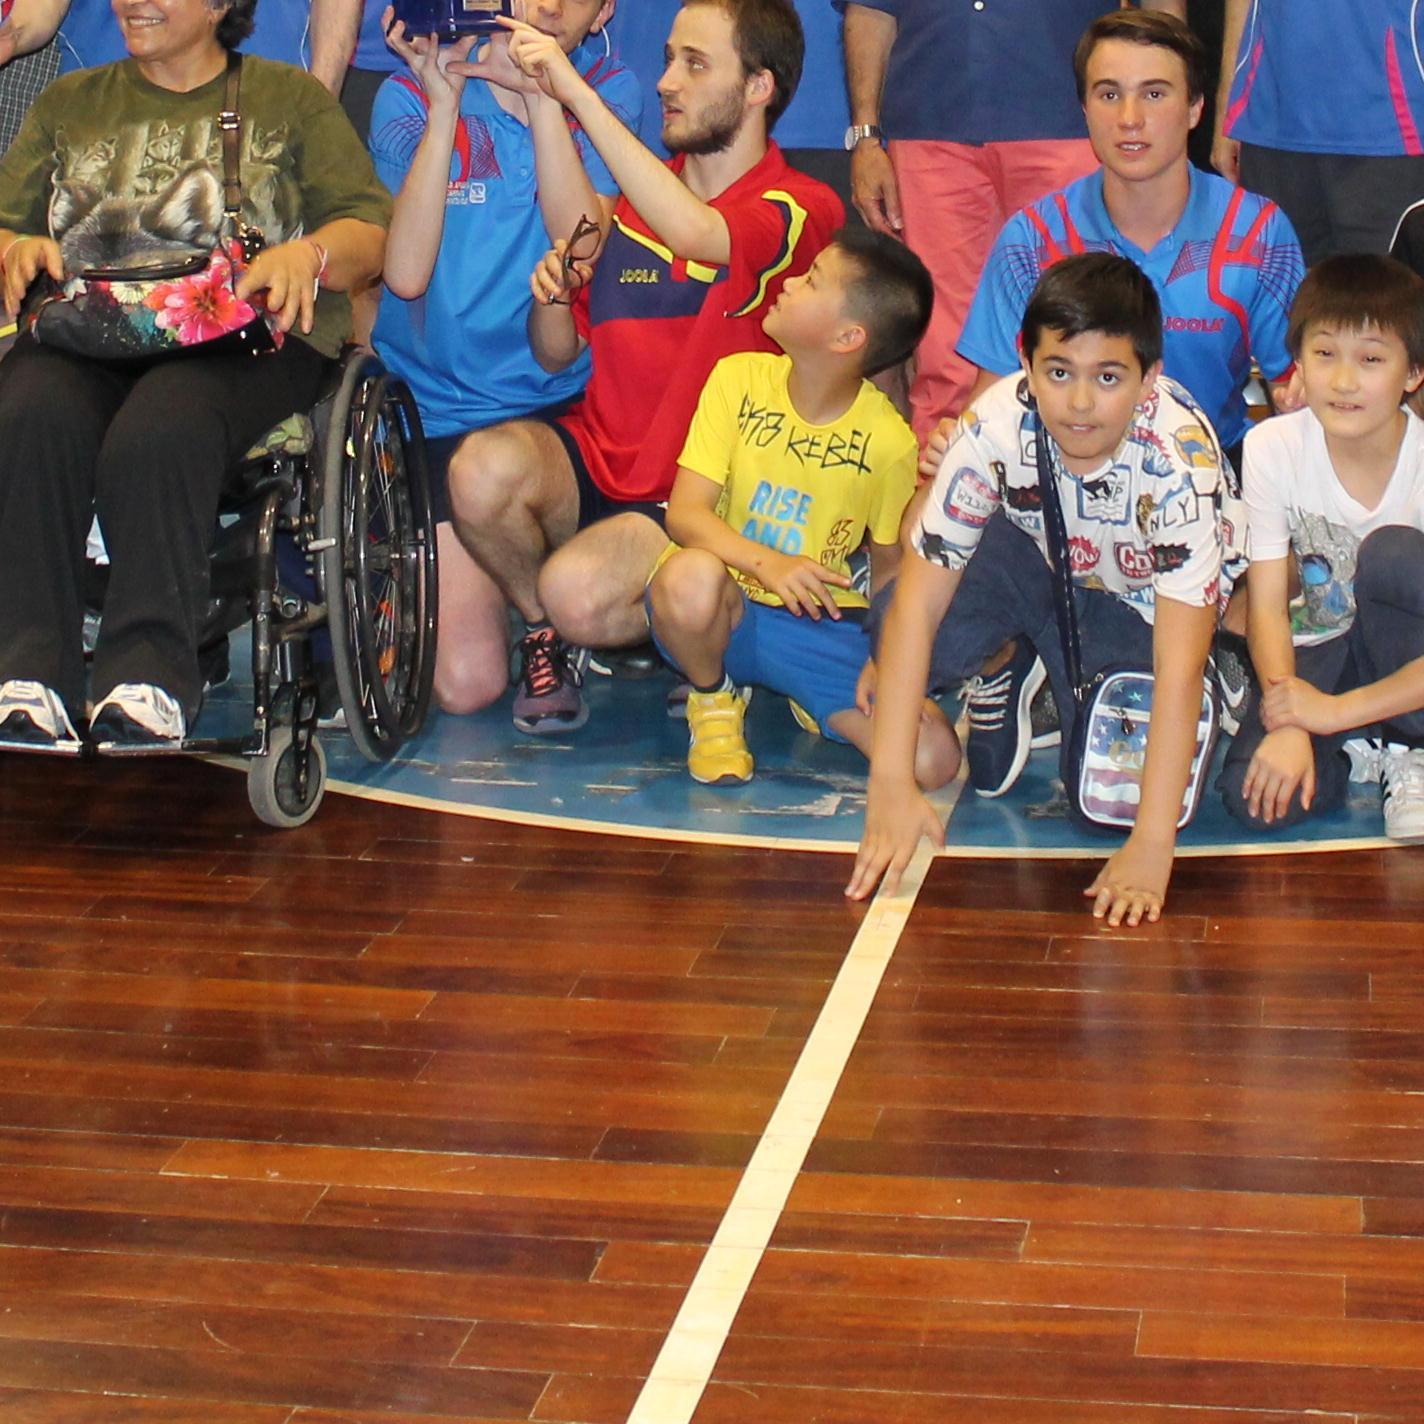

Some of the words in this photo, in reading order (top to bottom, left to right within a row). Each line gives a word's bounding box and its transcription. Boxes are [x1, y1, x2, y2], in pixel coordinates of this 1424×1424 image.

[619, 269, 659, 283] JOOLA
[1164, 316, 1225, 333] JOOLA
[748, 479, 814, 526] RISE
